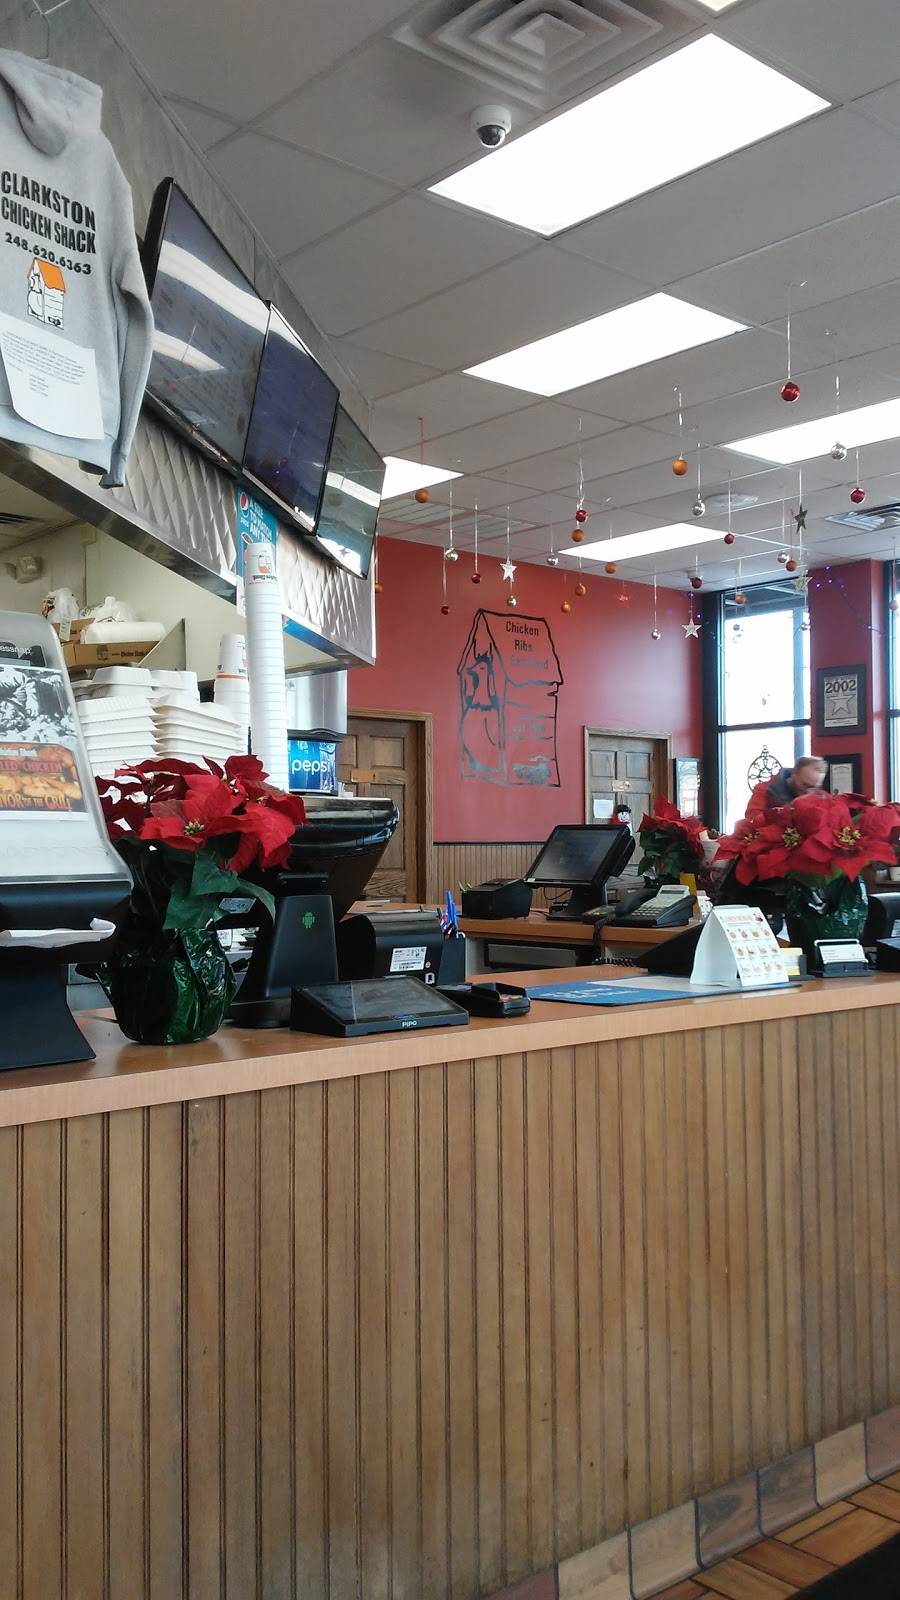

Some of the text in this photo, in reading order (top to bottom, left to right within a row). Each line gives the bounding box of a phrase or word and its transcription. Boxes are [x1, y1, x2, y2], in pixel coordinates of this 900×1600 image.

[1, 170, 96, 232] CLARKSTON
[1, 196, 96, 254] CHICKEN SHACK
[5, 232, 92, 275] 248.620.6363
[505, 621, 539, 637] Chicken
[514, 639, 533, 652] Ribs
[825, 679, 857, 694] 2002
